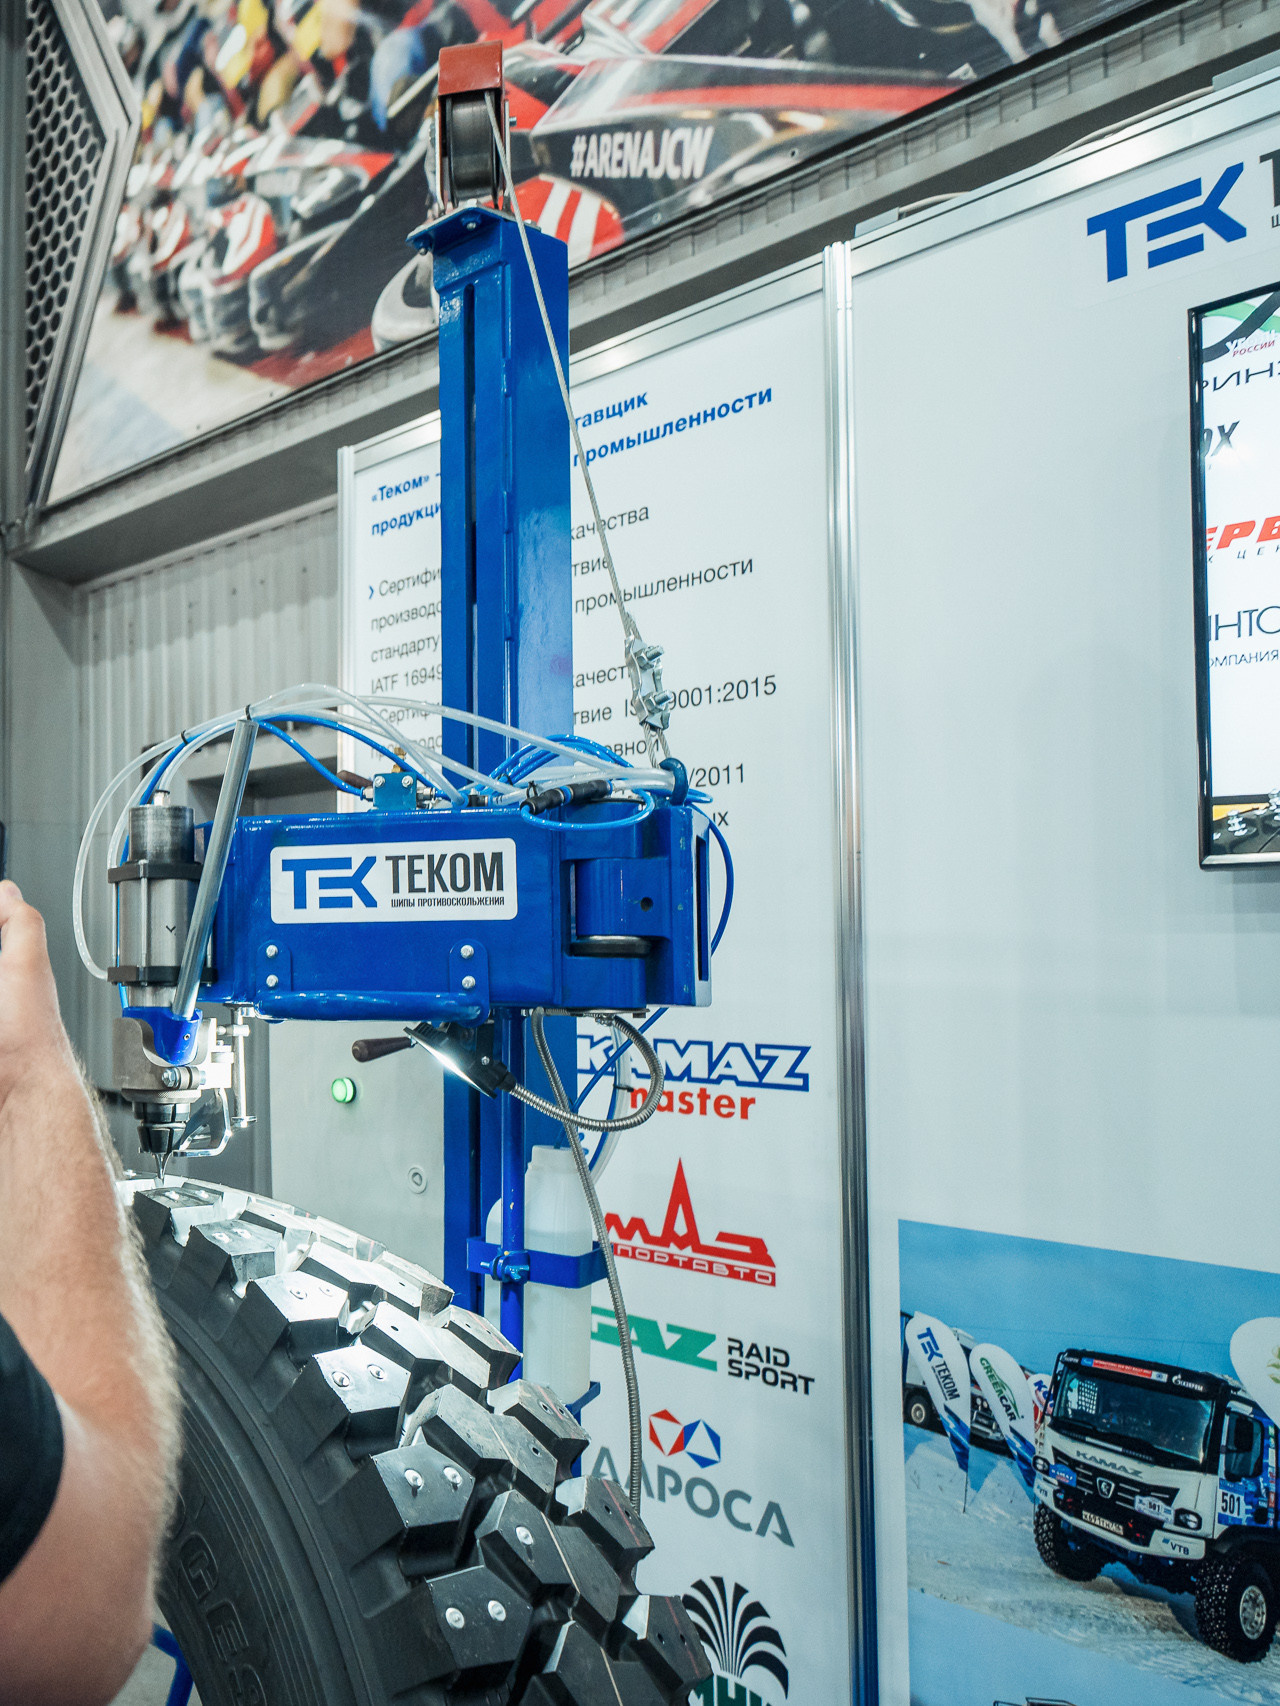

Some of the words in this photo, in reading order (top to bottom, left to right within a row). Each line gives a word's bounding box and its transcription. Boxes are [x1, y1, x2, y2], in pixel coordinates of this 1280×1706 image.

[570, 126, 715, 179] #ARENAJCW
[371, 475, 430, 502] «Теком»
[371, 634, 440, 663] стандарту
[574, 558, 754, 616] промышленности
[371, 672, 399, 695] IATF
[572, 665, 631, 689] ачест
[385, 851, 504, 894] ТЕКОМ
[391, 897, 415, 908] ШИПЫ
[417, 896, 505, 907] ПРОТИВОСКОЛЬЖЕНИЯ
[727, 1336, 791, 1368] RAID
[727, 1359, 816, 1396] SPORT
[1076, 1450, 1144, 1480] KAMAZ
[1221, 1491, 1241, 1517] 501
[1170, 1541, 1190, 1556] VTB
